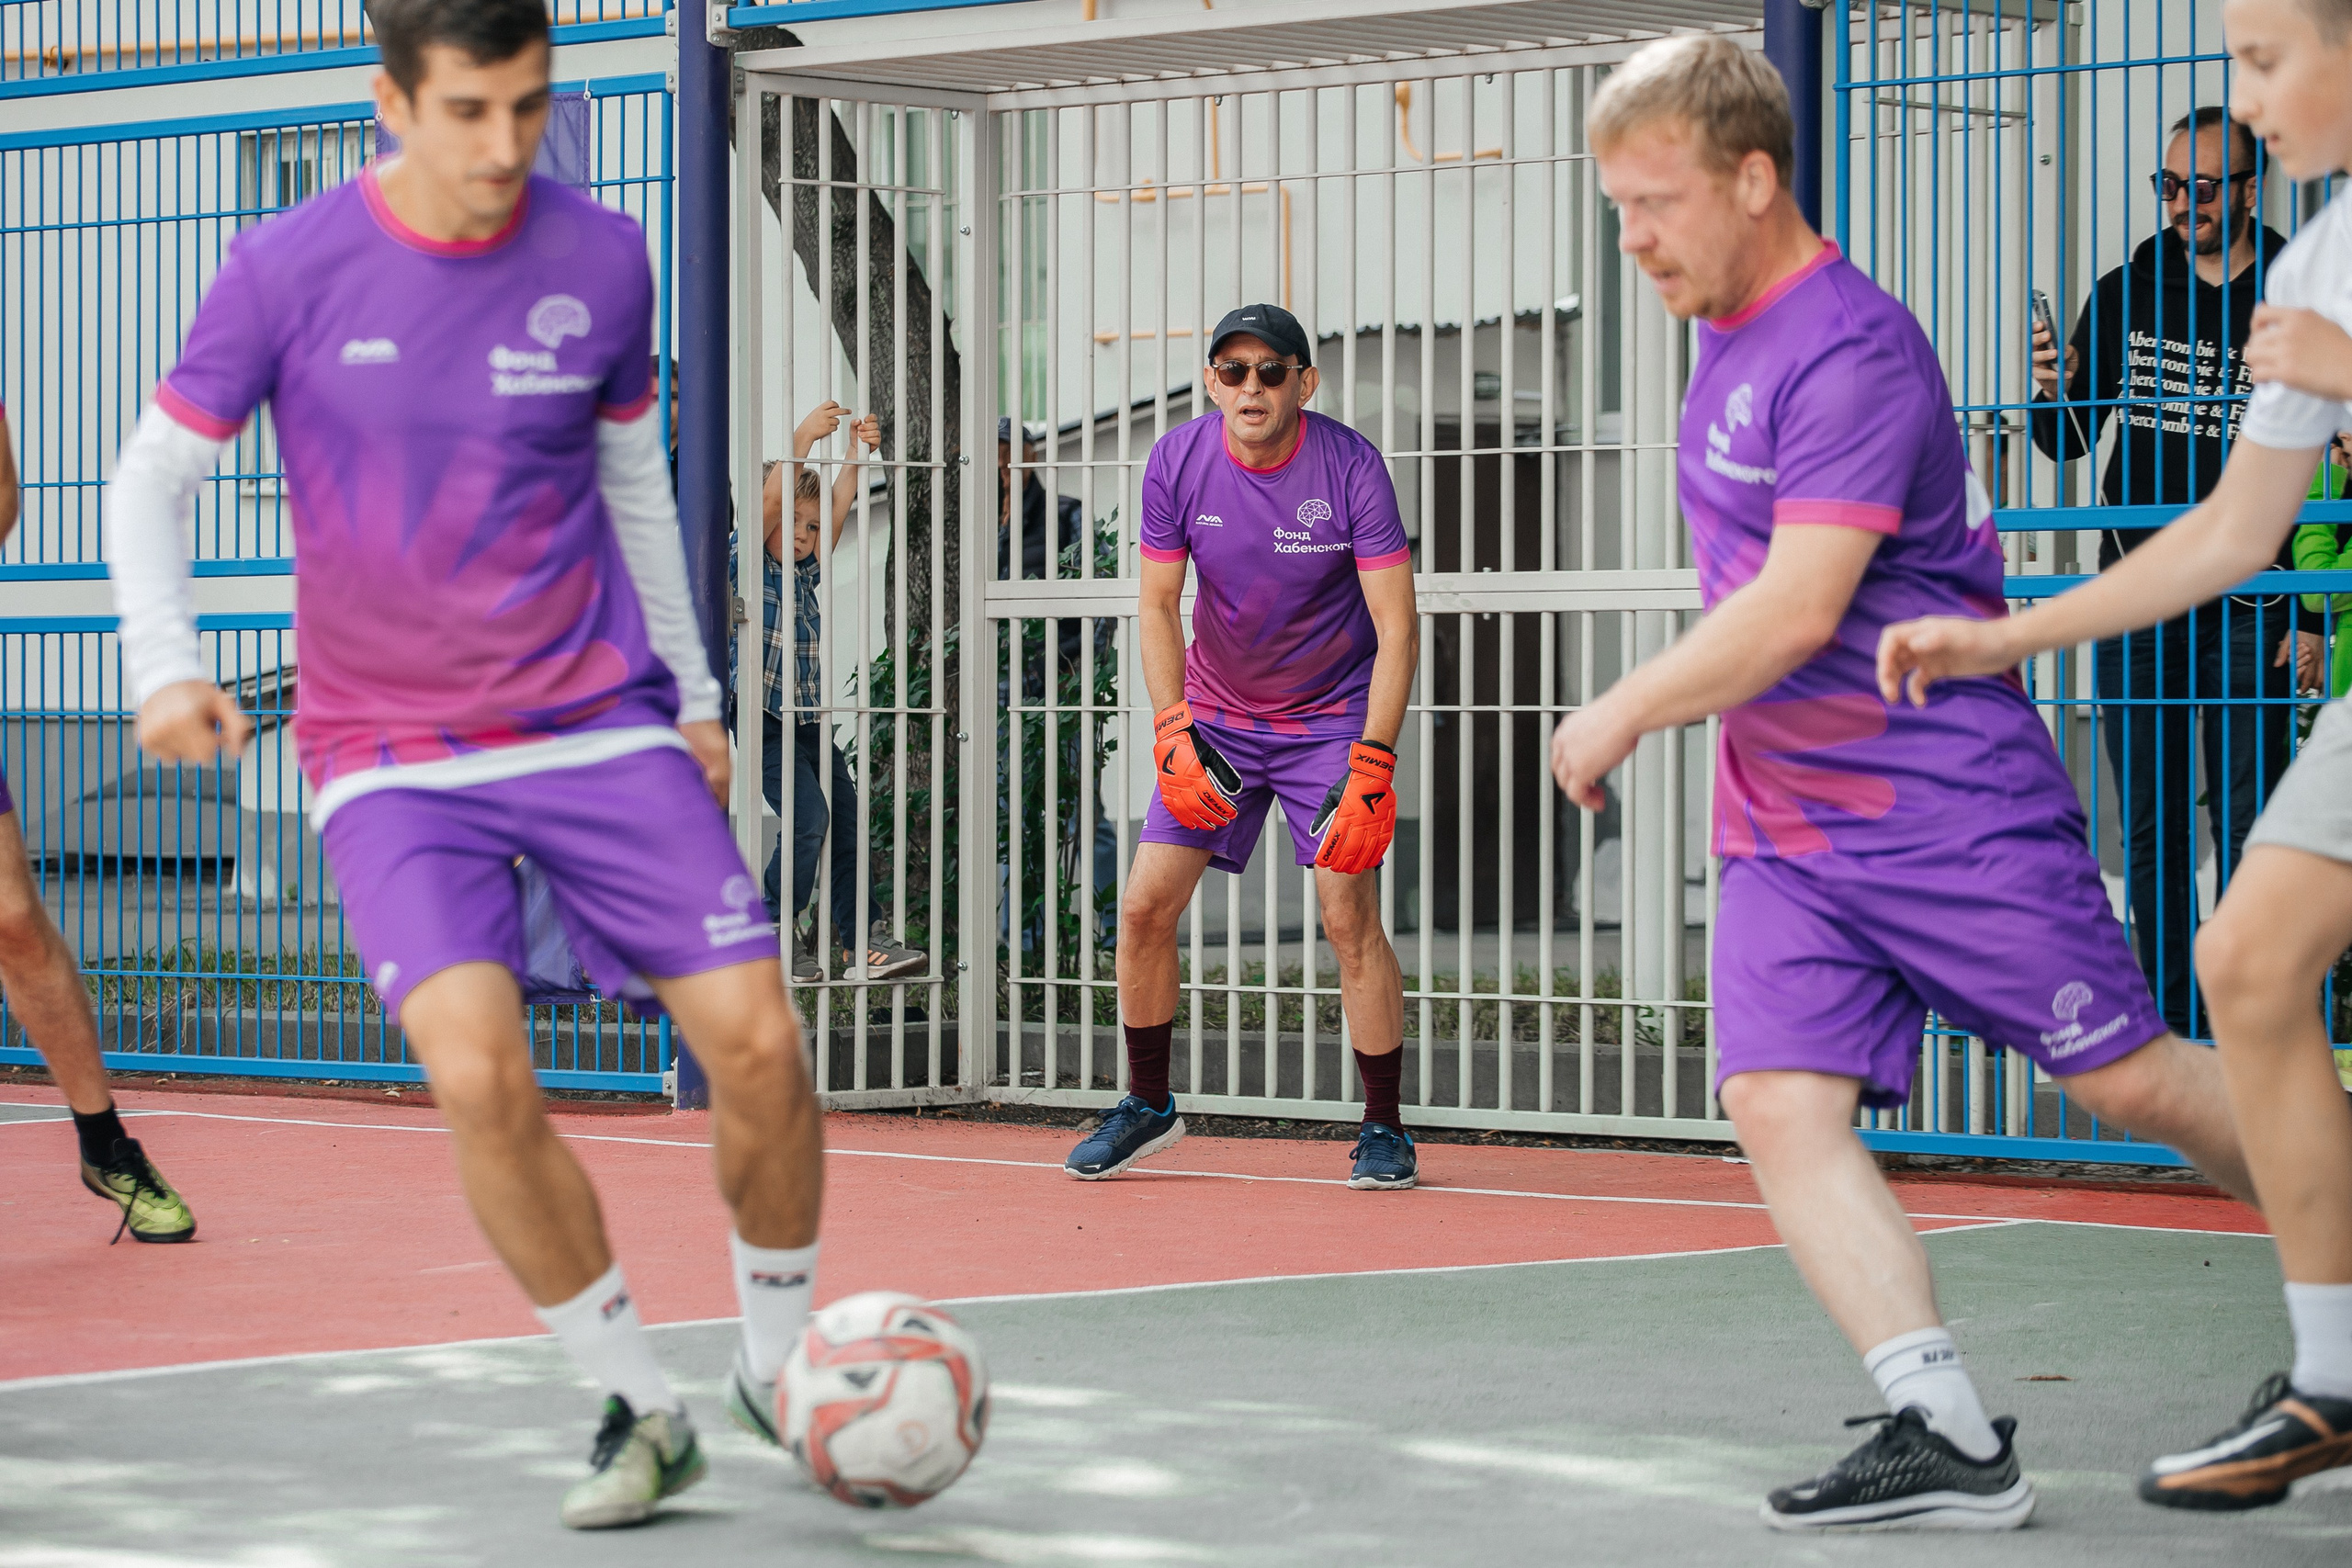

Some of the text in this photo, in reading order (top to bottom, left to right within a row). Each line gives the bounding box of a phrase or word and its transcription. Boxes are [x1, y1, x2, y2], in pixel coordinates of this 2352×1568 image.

[1273, 526, 1312, 541] Фонд
[1155, 710, 1185, 736] DEMI
[1355, 753, 1395, 773] DEMIX
